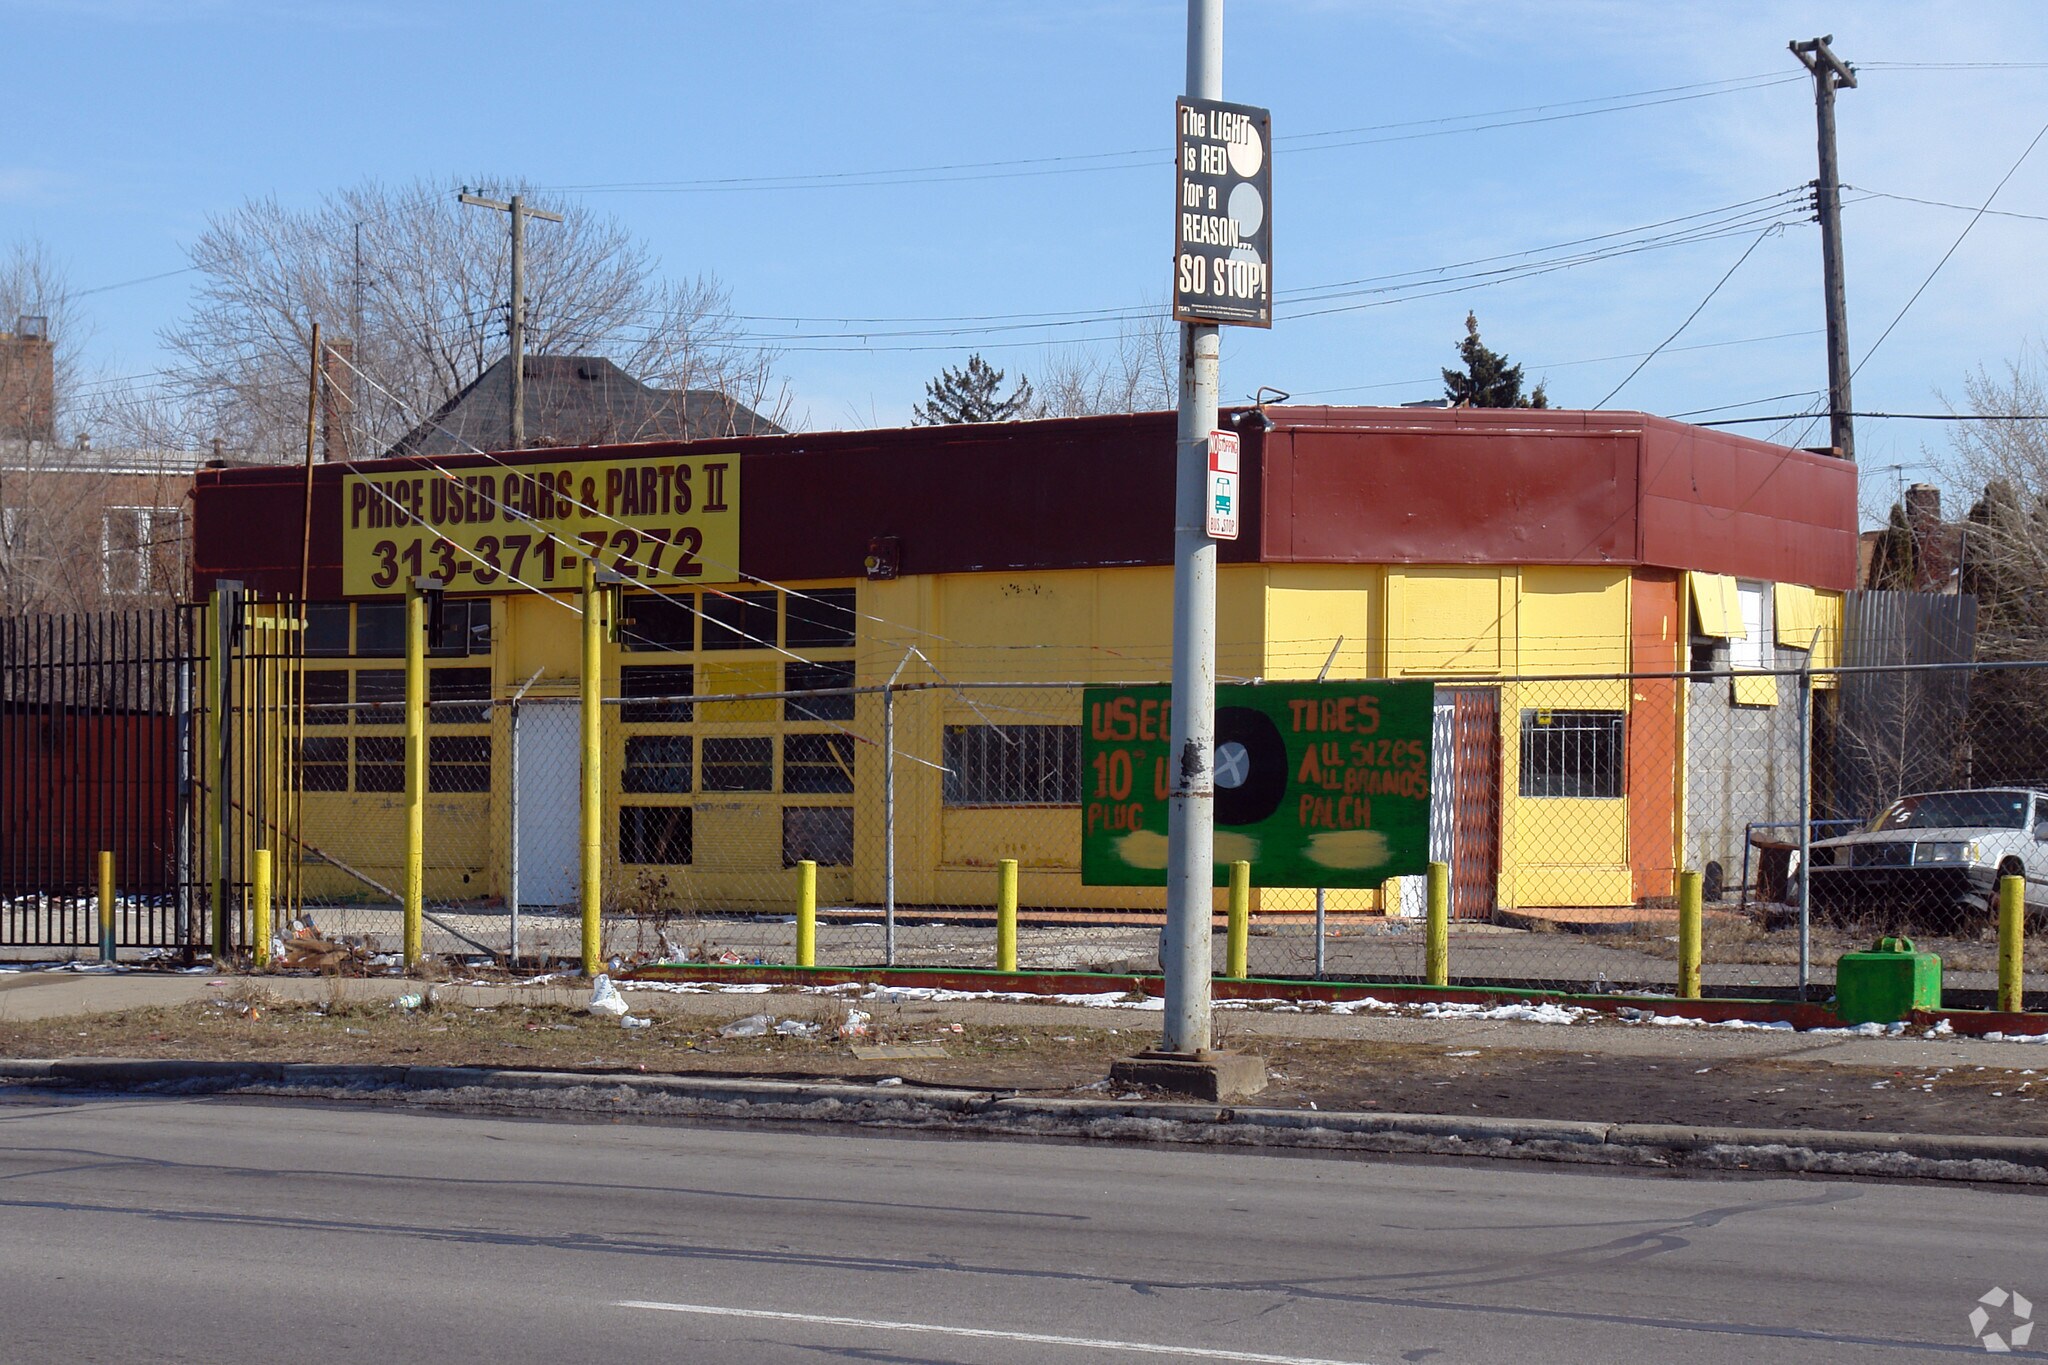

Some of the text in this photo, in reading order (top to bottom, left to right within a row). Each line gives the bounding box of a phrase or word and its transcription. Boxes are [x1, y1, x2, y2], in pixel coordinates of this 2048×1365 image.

[1181, 105, 1250, 146] The LIGHT
[1184, 141, 1227, 175] is RED
[1183, 177, 1217, 210] for a
[1182, 212, 1253, 251] REASON...
[1179, 253, 1267, 300] SO STOP!
[1209, 433, 1219, 455] NO
[351, 462, 729, 530] PRICE USED CARS & PARTS II
[1210, 516, 1235, 533] BUS STOP
[371, 526, 703, 590] 313-371-7272
[1288, 694, 1380, 735] TIRES
[1087, 801, 1143, 837] PLUG
